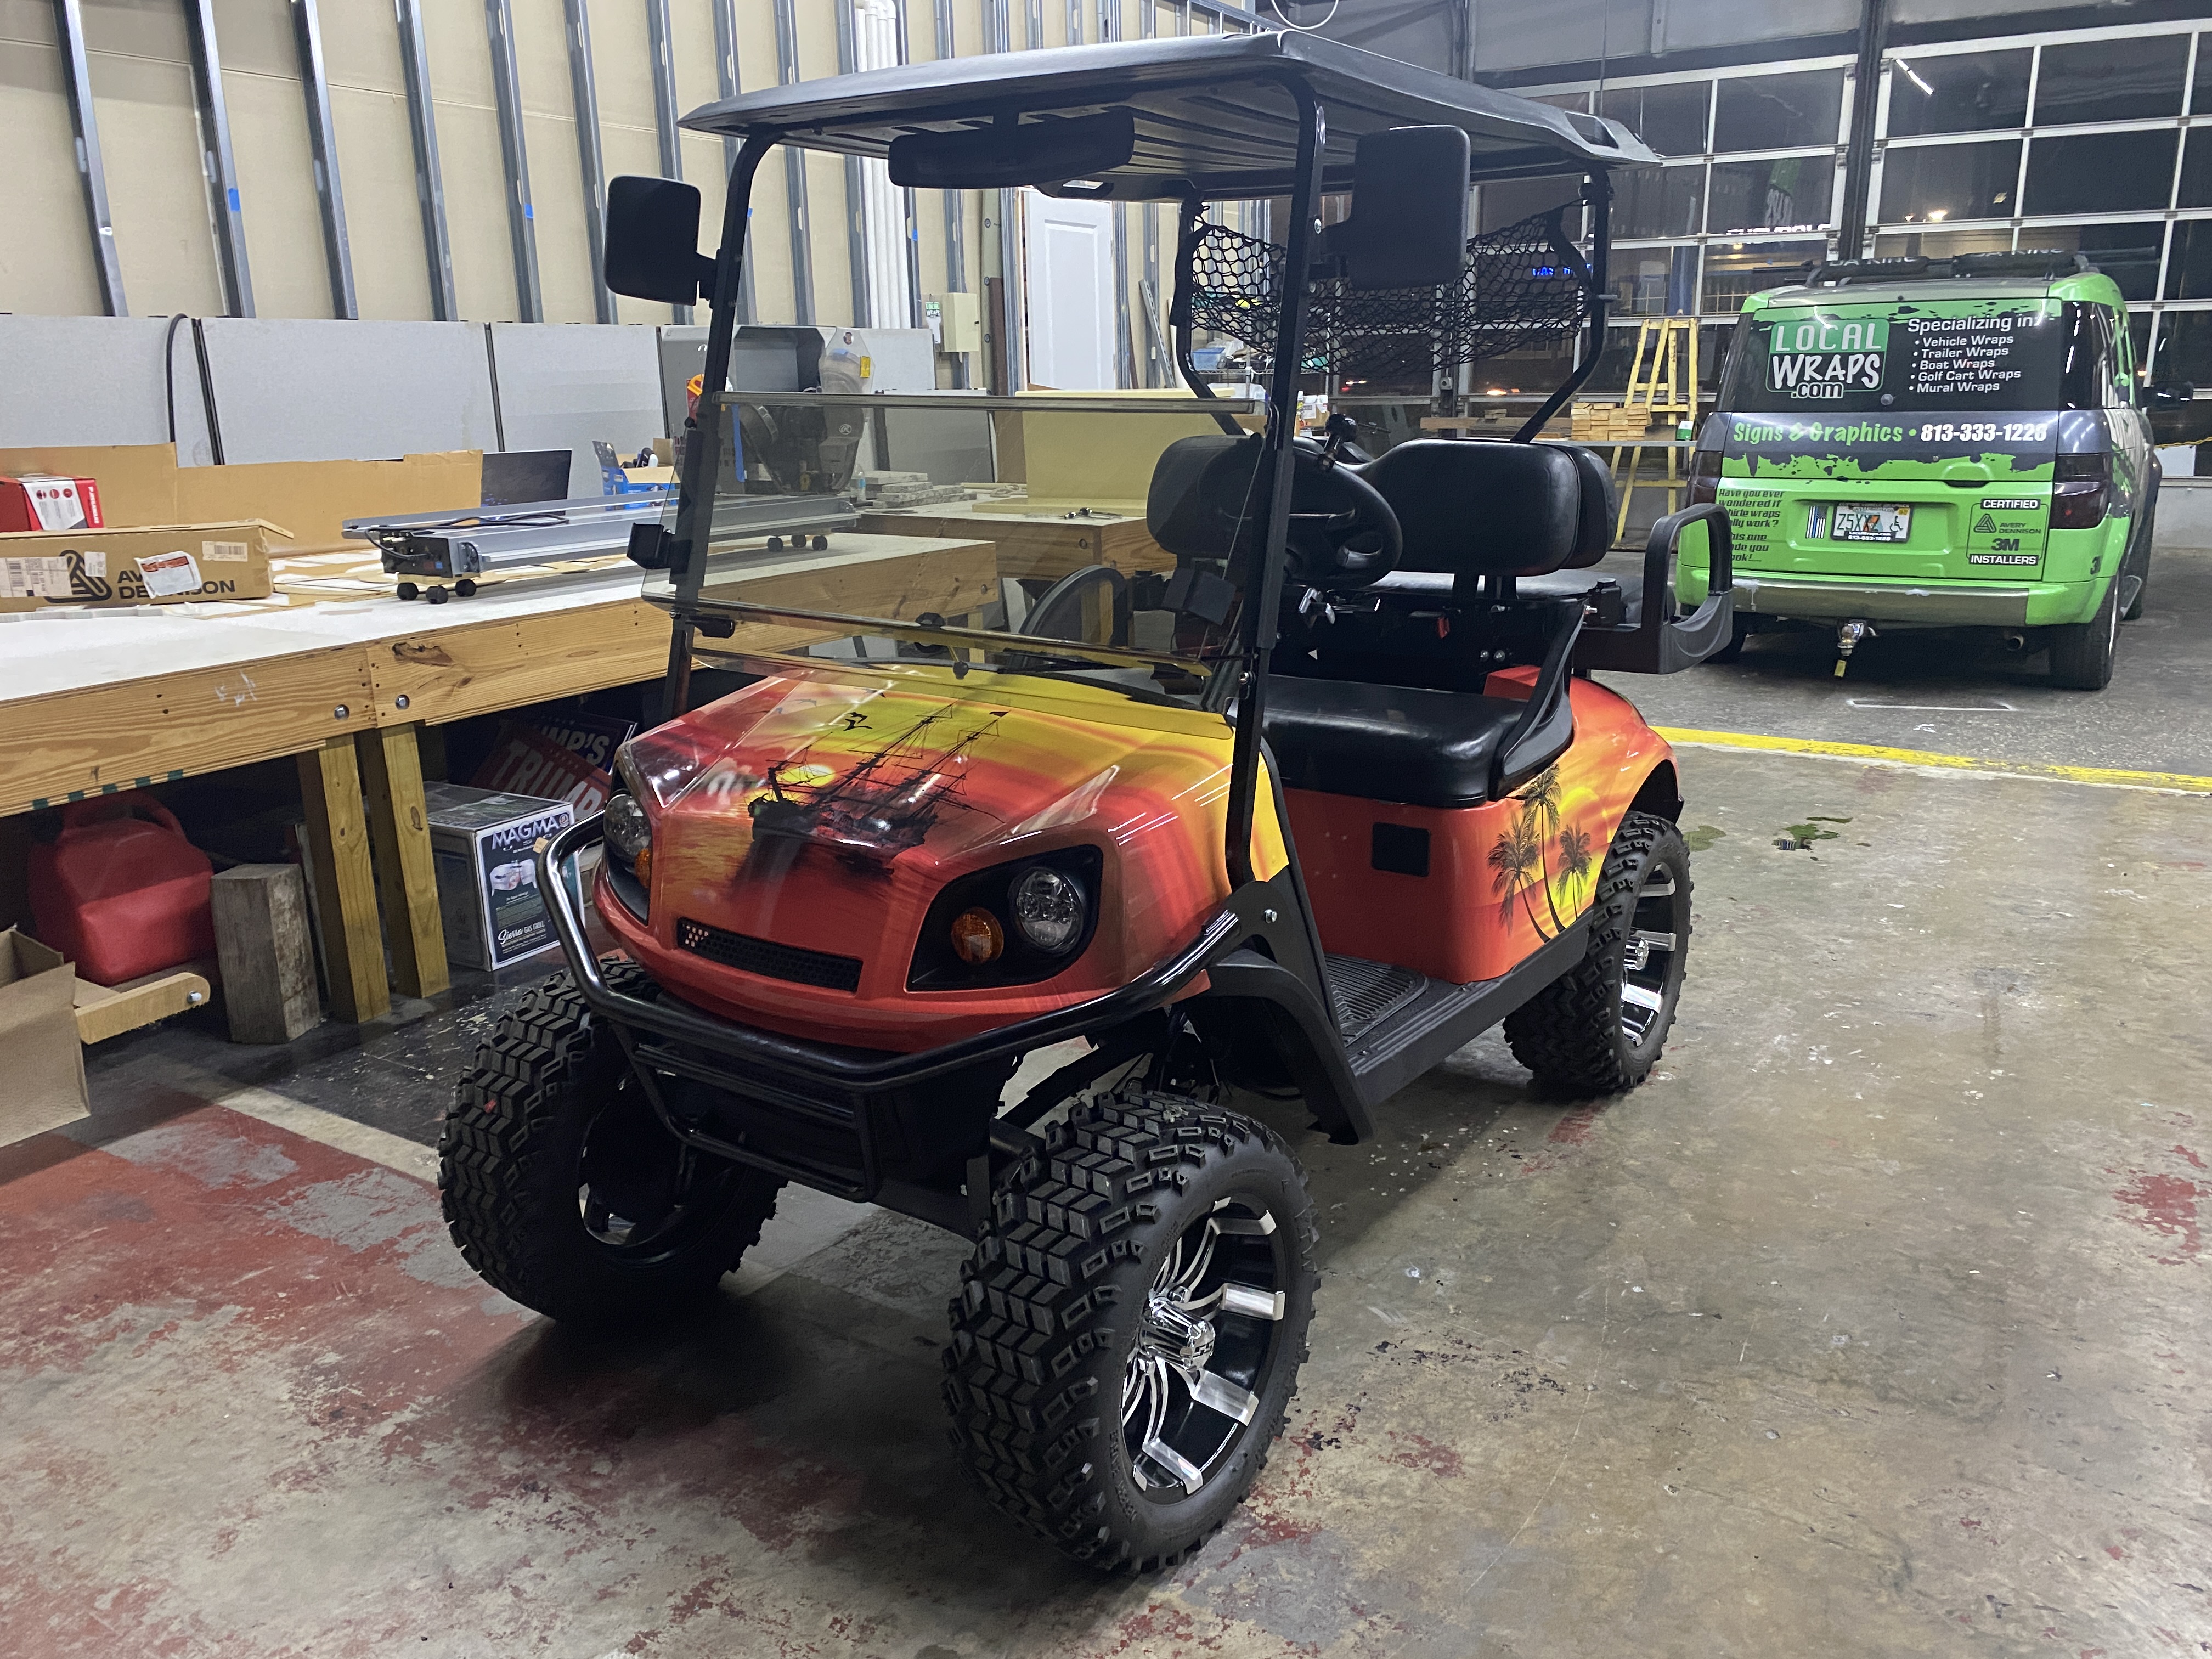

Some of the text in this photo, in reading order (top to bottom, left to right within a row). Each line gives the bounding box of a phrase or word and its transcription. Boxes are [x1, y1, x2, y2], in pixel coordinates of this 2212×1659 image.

[1908, 315, 2012, 335] Specializing
[1775, 323, 1882, 351] LOCAL
[1923, 335, 2014, 347] Vehicle Wraps
[1921, 347, 2009, 358] Trailer Wraps
[1920, 359, 1995, 370] Boat Wraps
[1772, 353, 1880, 390] WRAPS
[1918, 370, 2022, 381] Golf Cart Wraps
[1791, 382, 1844, 399] .com
[1917, 382, 2000, 393] Mural Wraps
[1734, 422, 1783, 445] Signs
[1809, 421, 1903, 446] Graphics
[1921, 423, 2048, 442] 813-333-1228
[1718, 489, 1741, 497] Have
[1983, 500, 2038, 509] CERTIFIED
[1728, 509, 1781, 519] hicle wraps
[1991, 538, 2020, 551] 3M
[1971, 555, 2036, 564] INSTALLERS
[492, 816, 560, 850] MAGMA
